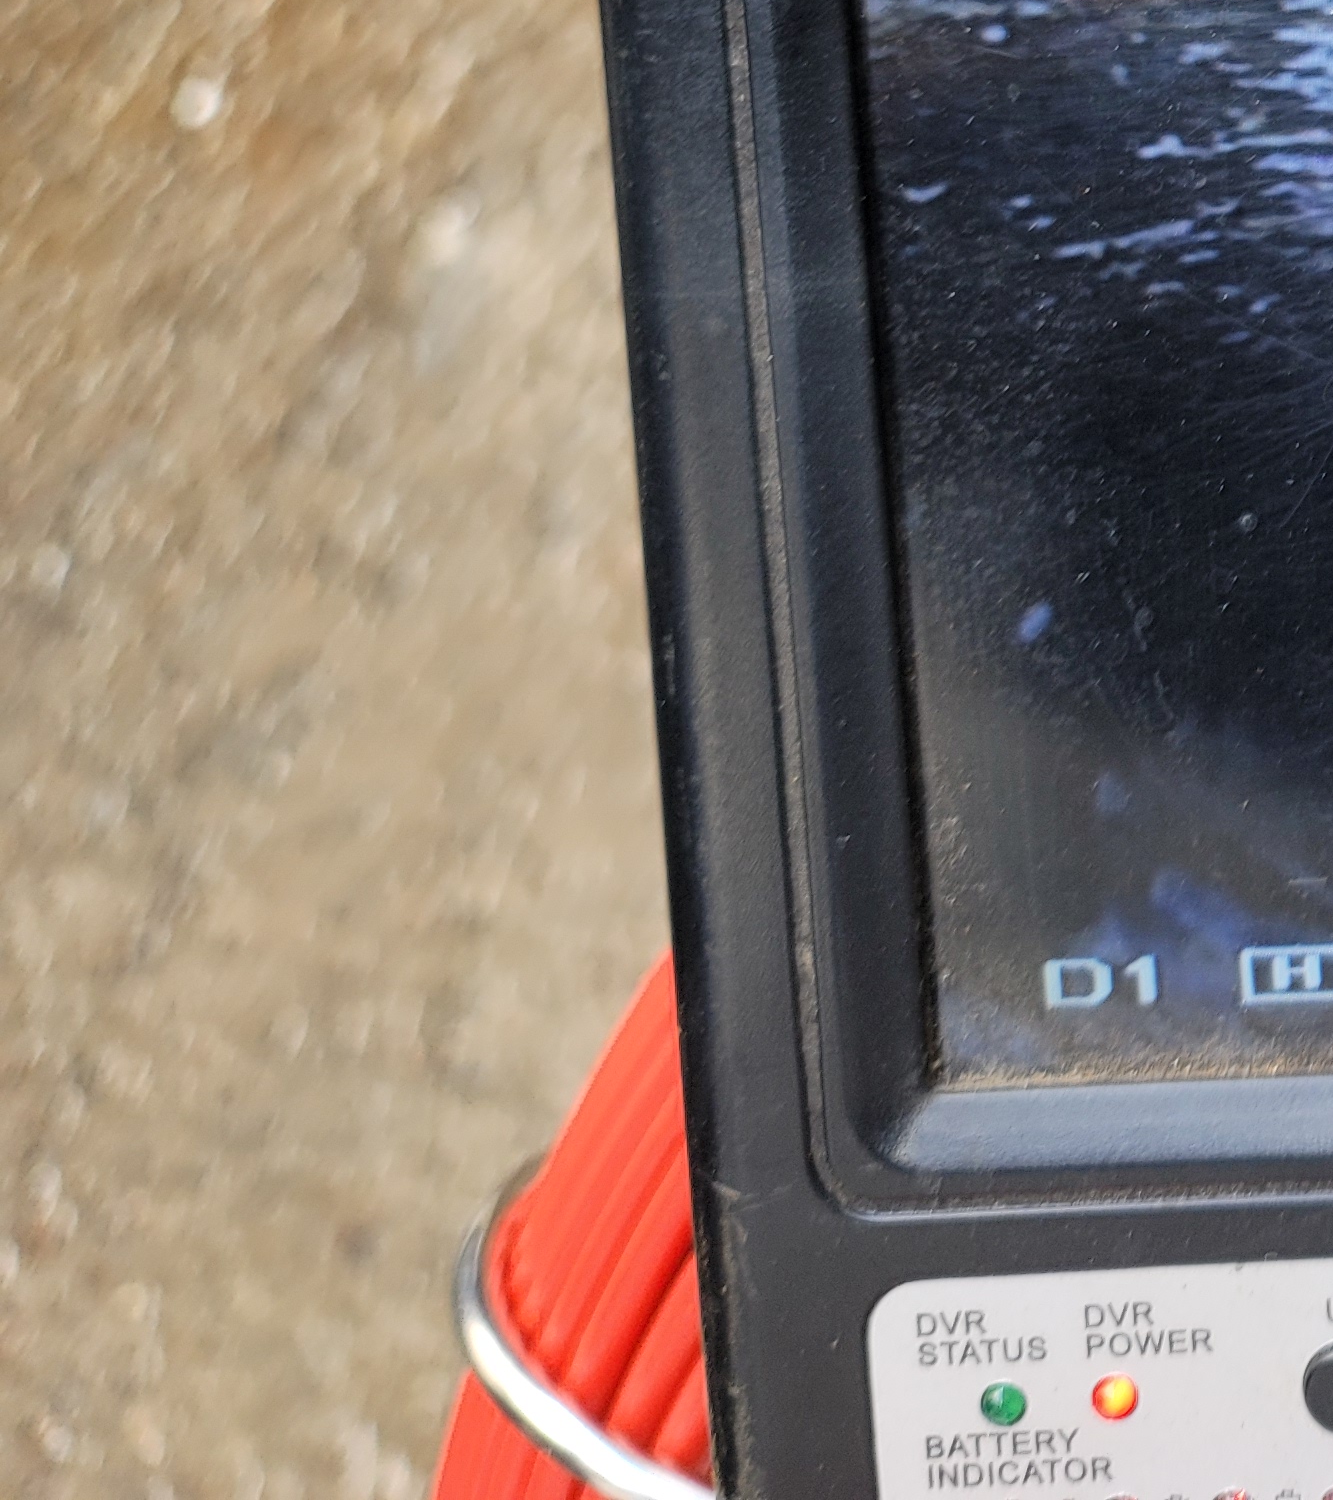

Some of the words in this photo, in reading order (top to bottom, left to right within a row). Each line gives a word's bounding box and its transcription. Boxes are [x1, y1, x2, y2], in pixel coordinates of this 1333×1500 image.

[1043, 953, 1160, 1008] D1
[915, 1311, 986, 1337] DVR
[1083, 1303, 1153, 1329] DVR
[917, 1337, 1048, 1366] STATUS
[1085, 1329, 1213, 1357] POWER
[925, 1428, 1080, 1460] BATTERY
[927, 1457, 1113, 1490] INDICATOR
